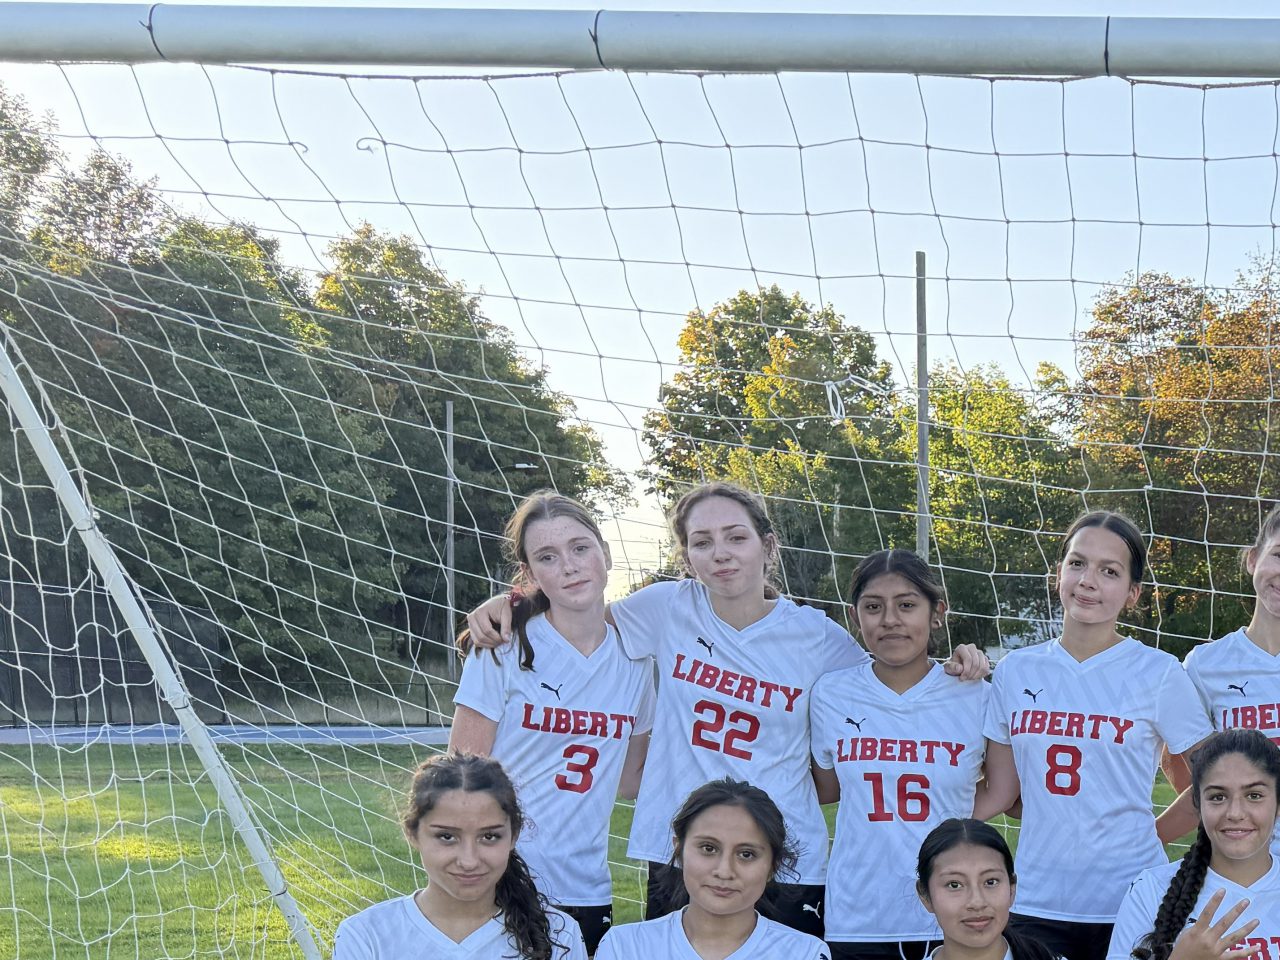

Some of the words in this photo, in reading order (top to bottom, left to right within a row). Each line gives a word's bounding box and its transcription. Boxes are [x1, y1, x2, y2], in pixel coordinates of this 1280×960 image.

[672, 654, 803, 712] LIBERTY
[691, 700, 761, 761] 22
[836, 737, 966, 767] LIBERTY
[1010, 709, 1135, 745] LIBERTY
[555, 744, 600, 794] 3
[1045, 743, 1083, 797] 8
[864, 772, 930, 823] 16
